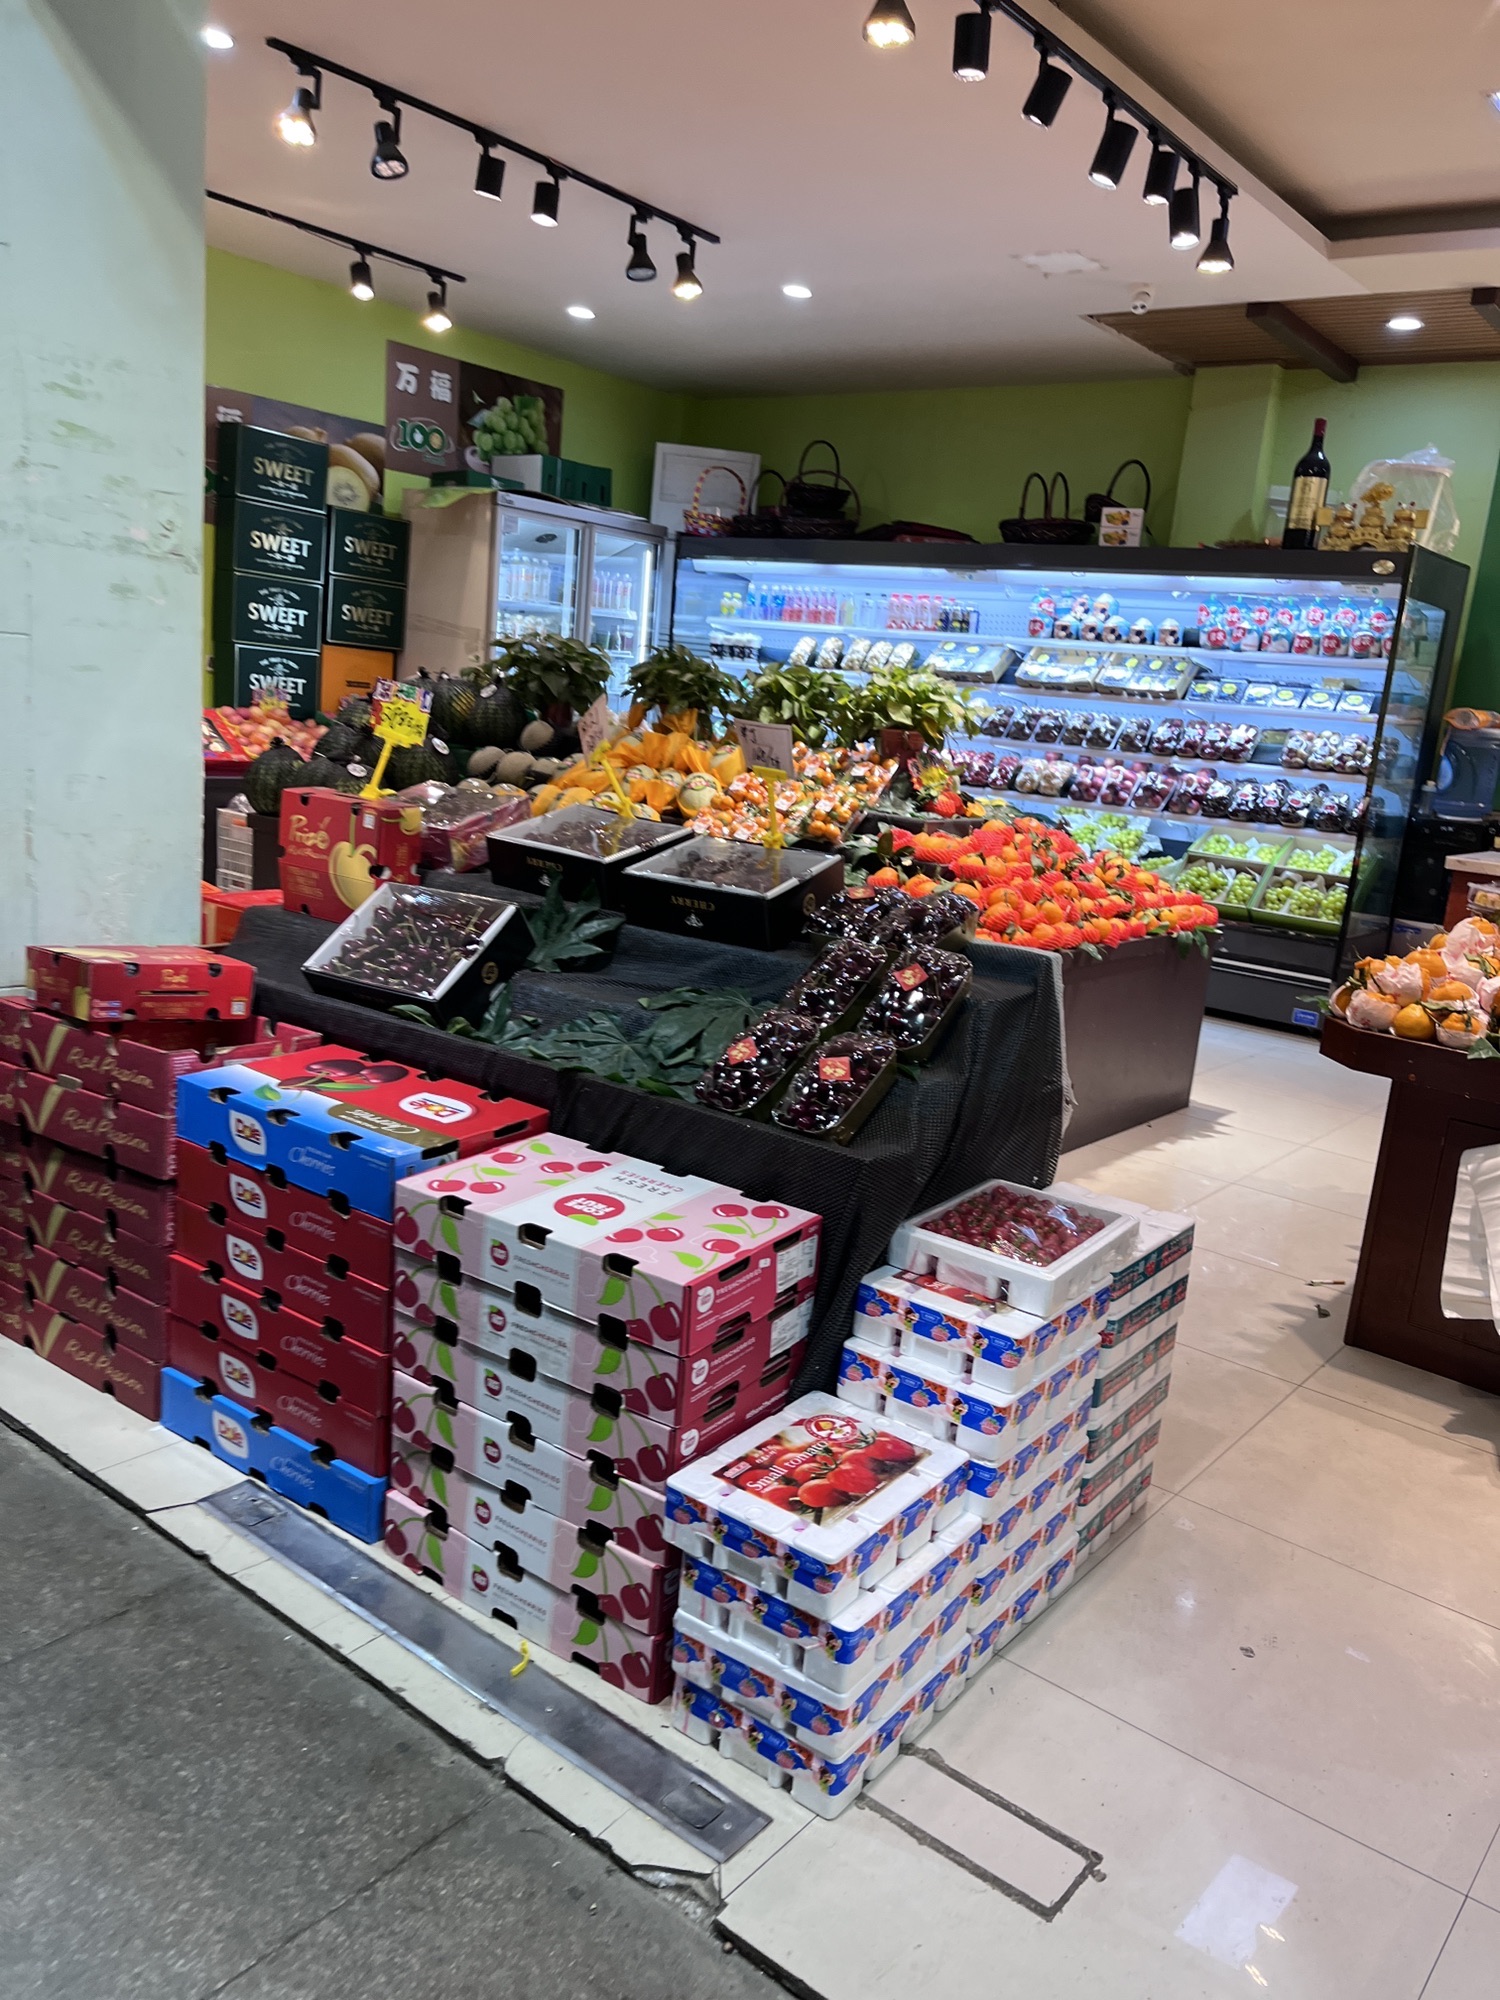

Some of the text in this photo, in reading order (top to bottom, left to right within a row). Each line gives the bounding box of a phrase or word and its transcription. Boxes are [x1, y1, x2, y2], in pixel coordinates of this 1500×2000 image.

[395, 361, 453, 403] 万福
[253, 456, 315, 486] SWEET
[250, 530, 313, 558] SWEET
[344, 535, 398, 561] SWEET
[248, 602, 309, 627] SWEET
[341, 603, 394, 627] SWEET
[249, 673, 307, 695] SWEET
[671, 896, 716, 912] CHERRY
[409, 1100, 460, 1118] Dole
[235, 1118, 262, 1142] Dole
[235, 1181, 262, 1205] Dole
[612, 1176, 671, 1197] FRESH
[618, 1170, 684, 1193] CHERRIES
[563, 1201, 606, 1216] COPE
[579, 1197, 616, 1213] FRUT
[232, 1242, 258, 1266] Dole
[228, 1302, 253, 1326] Dole
[225, 1360, 250, 1385] Dole
[218, 1419, 243, 1444] Dole
[746, 1465, 788, 1492] Small
[785, 1440, 829, 1468] tomato
